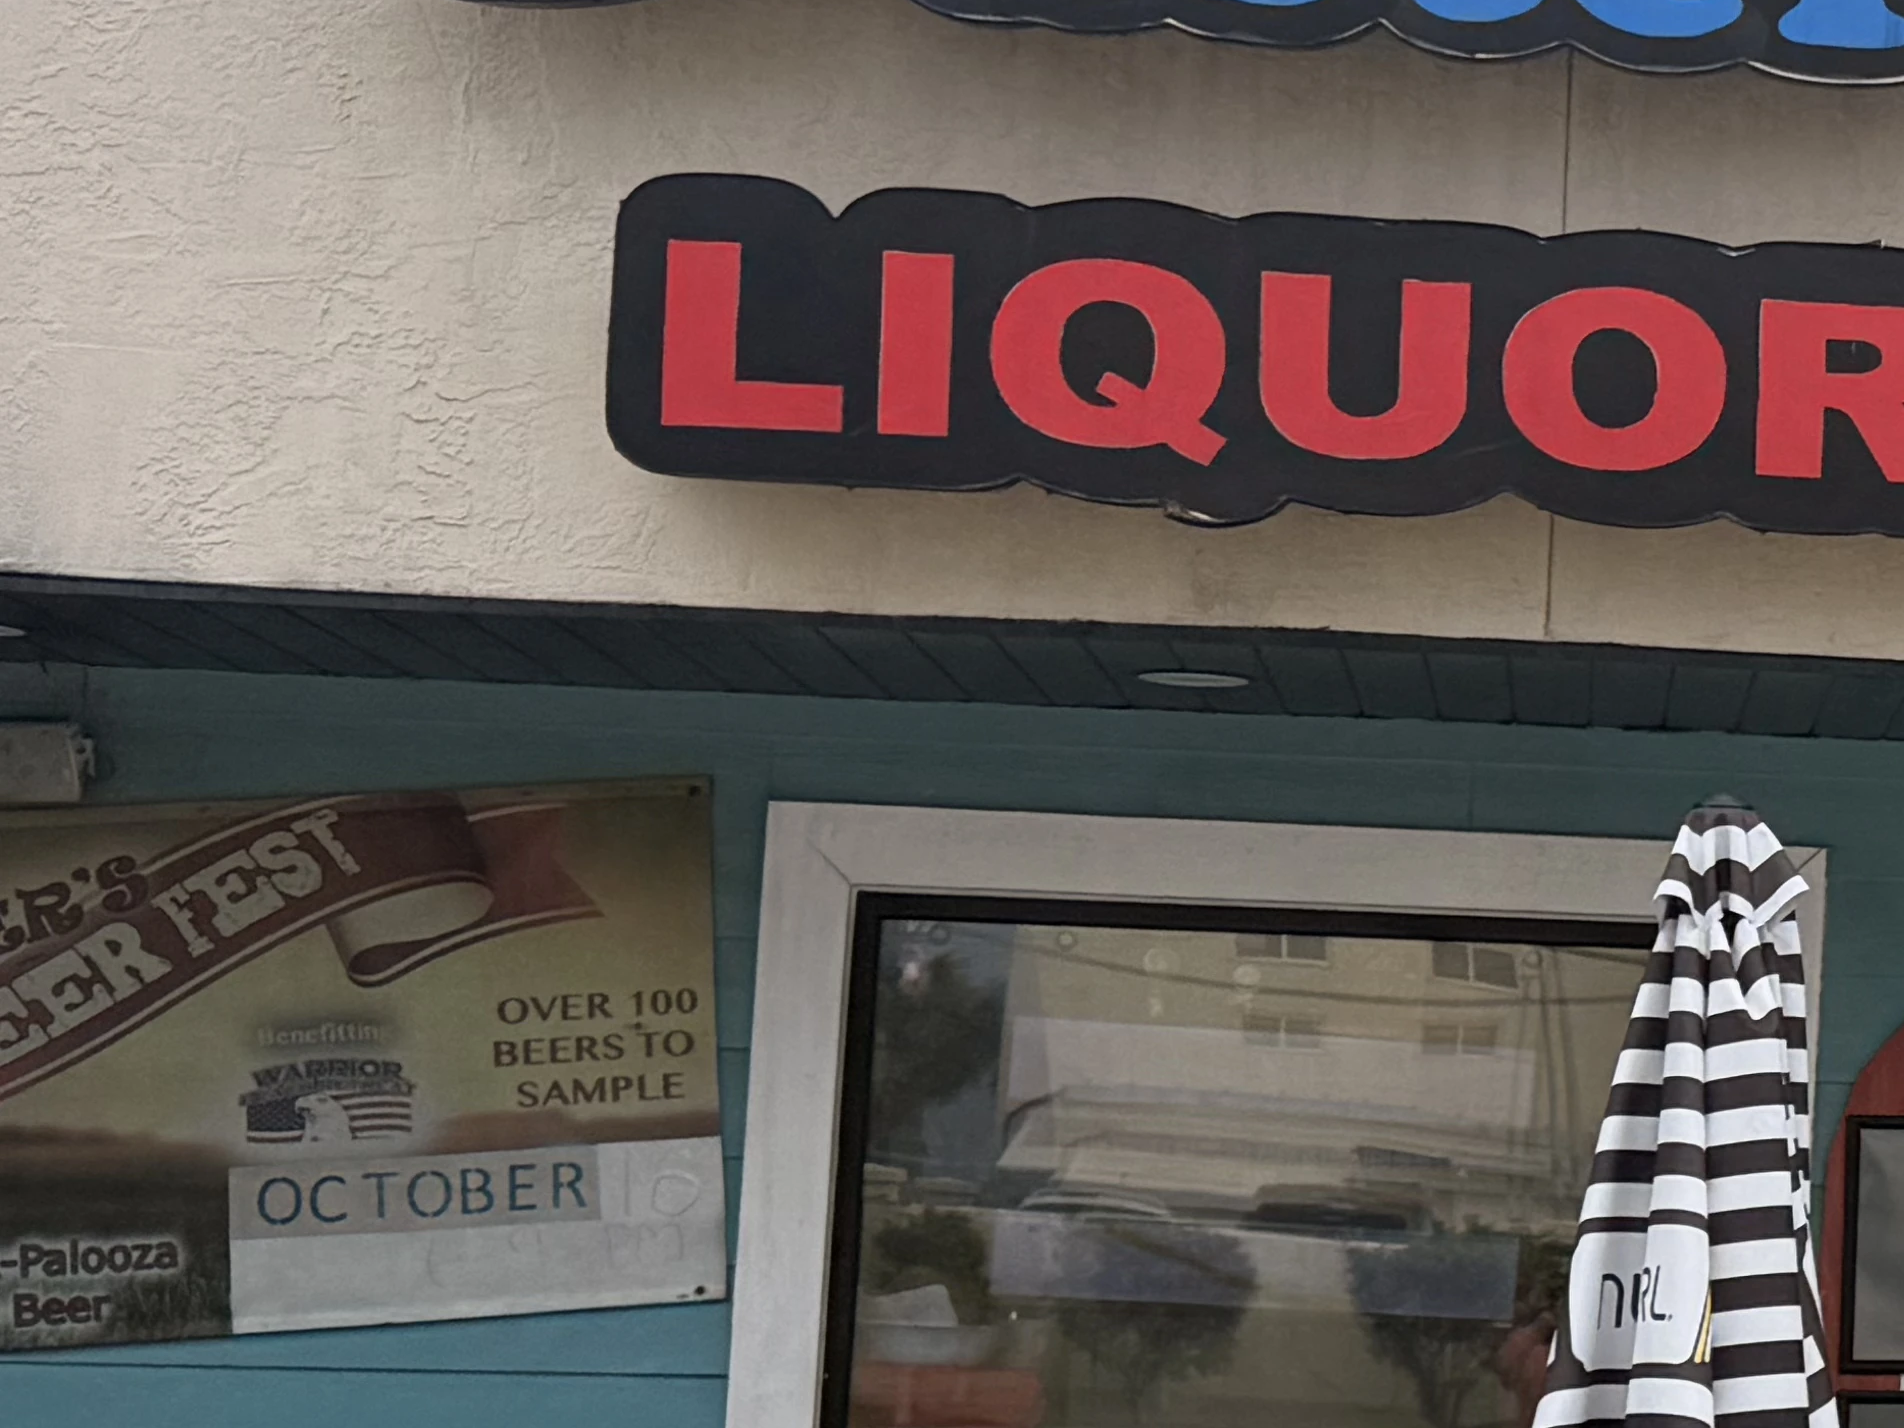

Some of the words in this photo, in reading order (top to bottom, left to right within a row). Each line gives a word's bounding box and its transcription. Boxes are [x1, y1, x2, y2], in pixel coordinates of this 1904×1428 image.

[151, 808, 361, 958] FEST
[497, 992, 613, 1024] OVER
[631, 988, 698, 1016] 100
[493, 1033, 625, 1068] BEERS
[636, 1029, 695, 1058] TO
[517, 1072, 686, 1108] SAMPLE
[257, 1162, 588, 1226] OCTOBER
[13, 1292, 112, 1329] Beer
